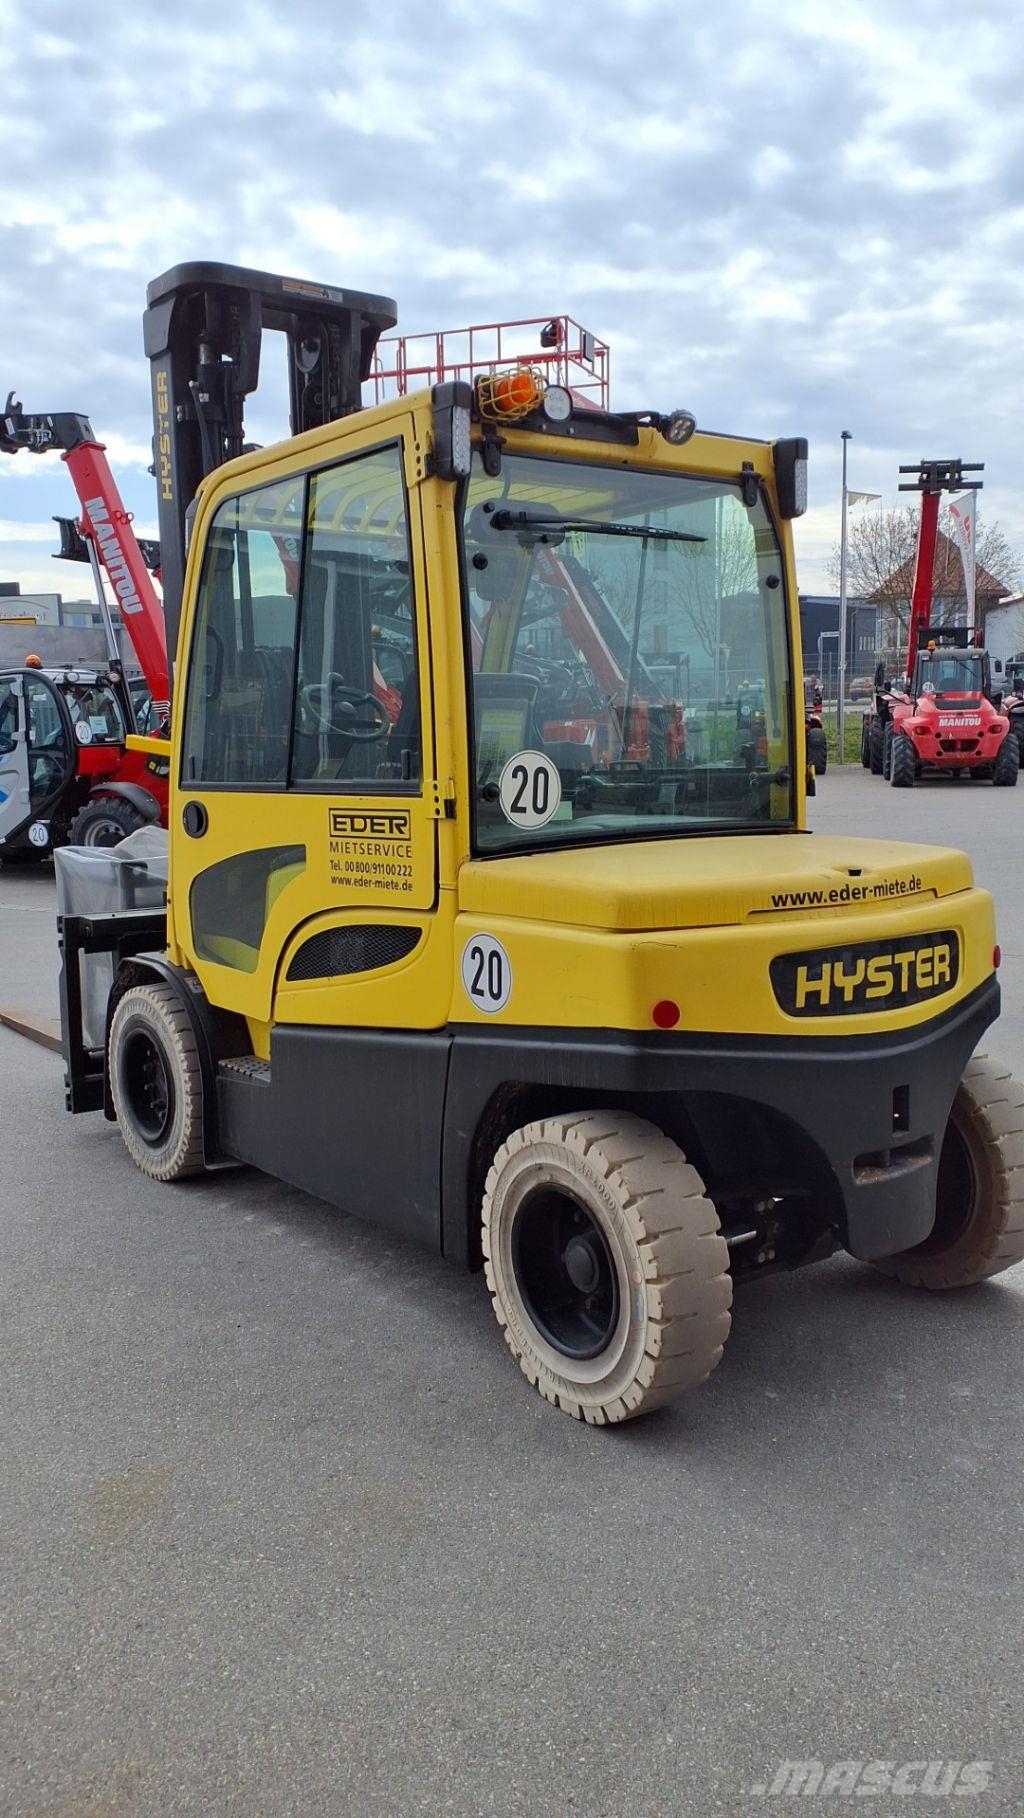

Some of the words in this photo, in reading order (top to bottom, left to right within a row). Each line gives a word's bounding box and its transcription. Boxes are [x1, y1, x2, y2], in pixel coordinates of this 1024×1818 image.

[156, 371, 173, 500] HYSTER
[85, 496, 144, 615] MANITOU
[938, 717, 982, 727] MANITOU
[510, 764, 550, 815] 20
[32, 827, 45, 842] 20
[332, 814, 408, 834] EDER
[330, 841, 412, 858] MIETSERVICE
[330, 860, 343, 871] Tel.
[331, 875, 413, 892] www.eder-miete.de
[771, 874, 922, 907] www.eder-miete.de
[470, 945, 503, 1001] 20
[795, 943, 951, 1008] HYSTER
